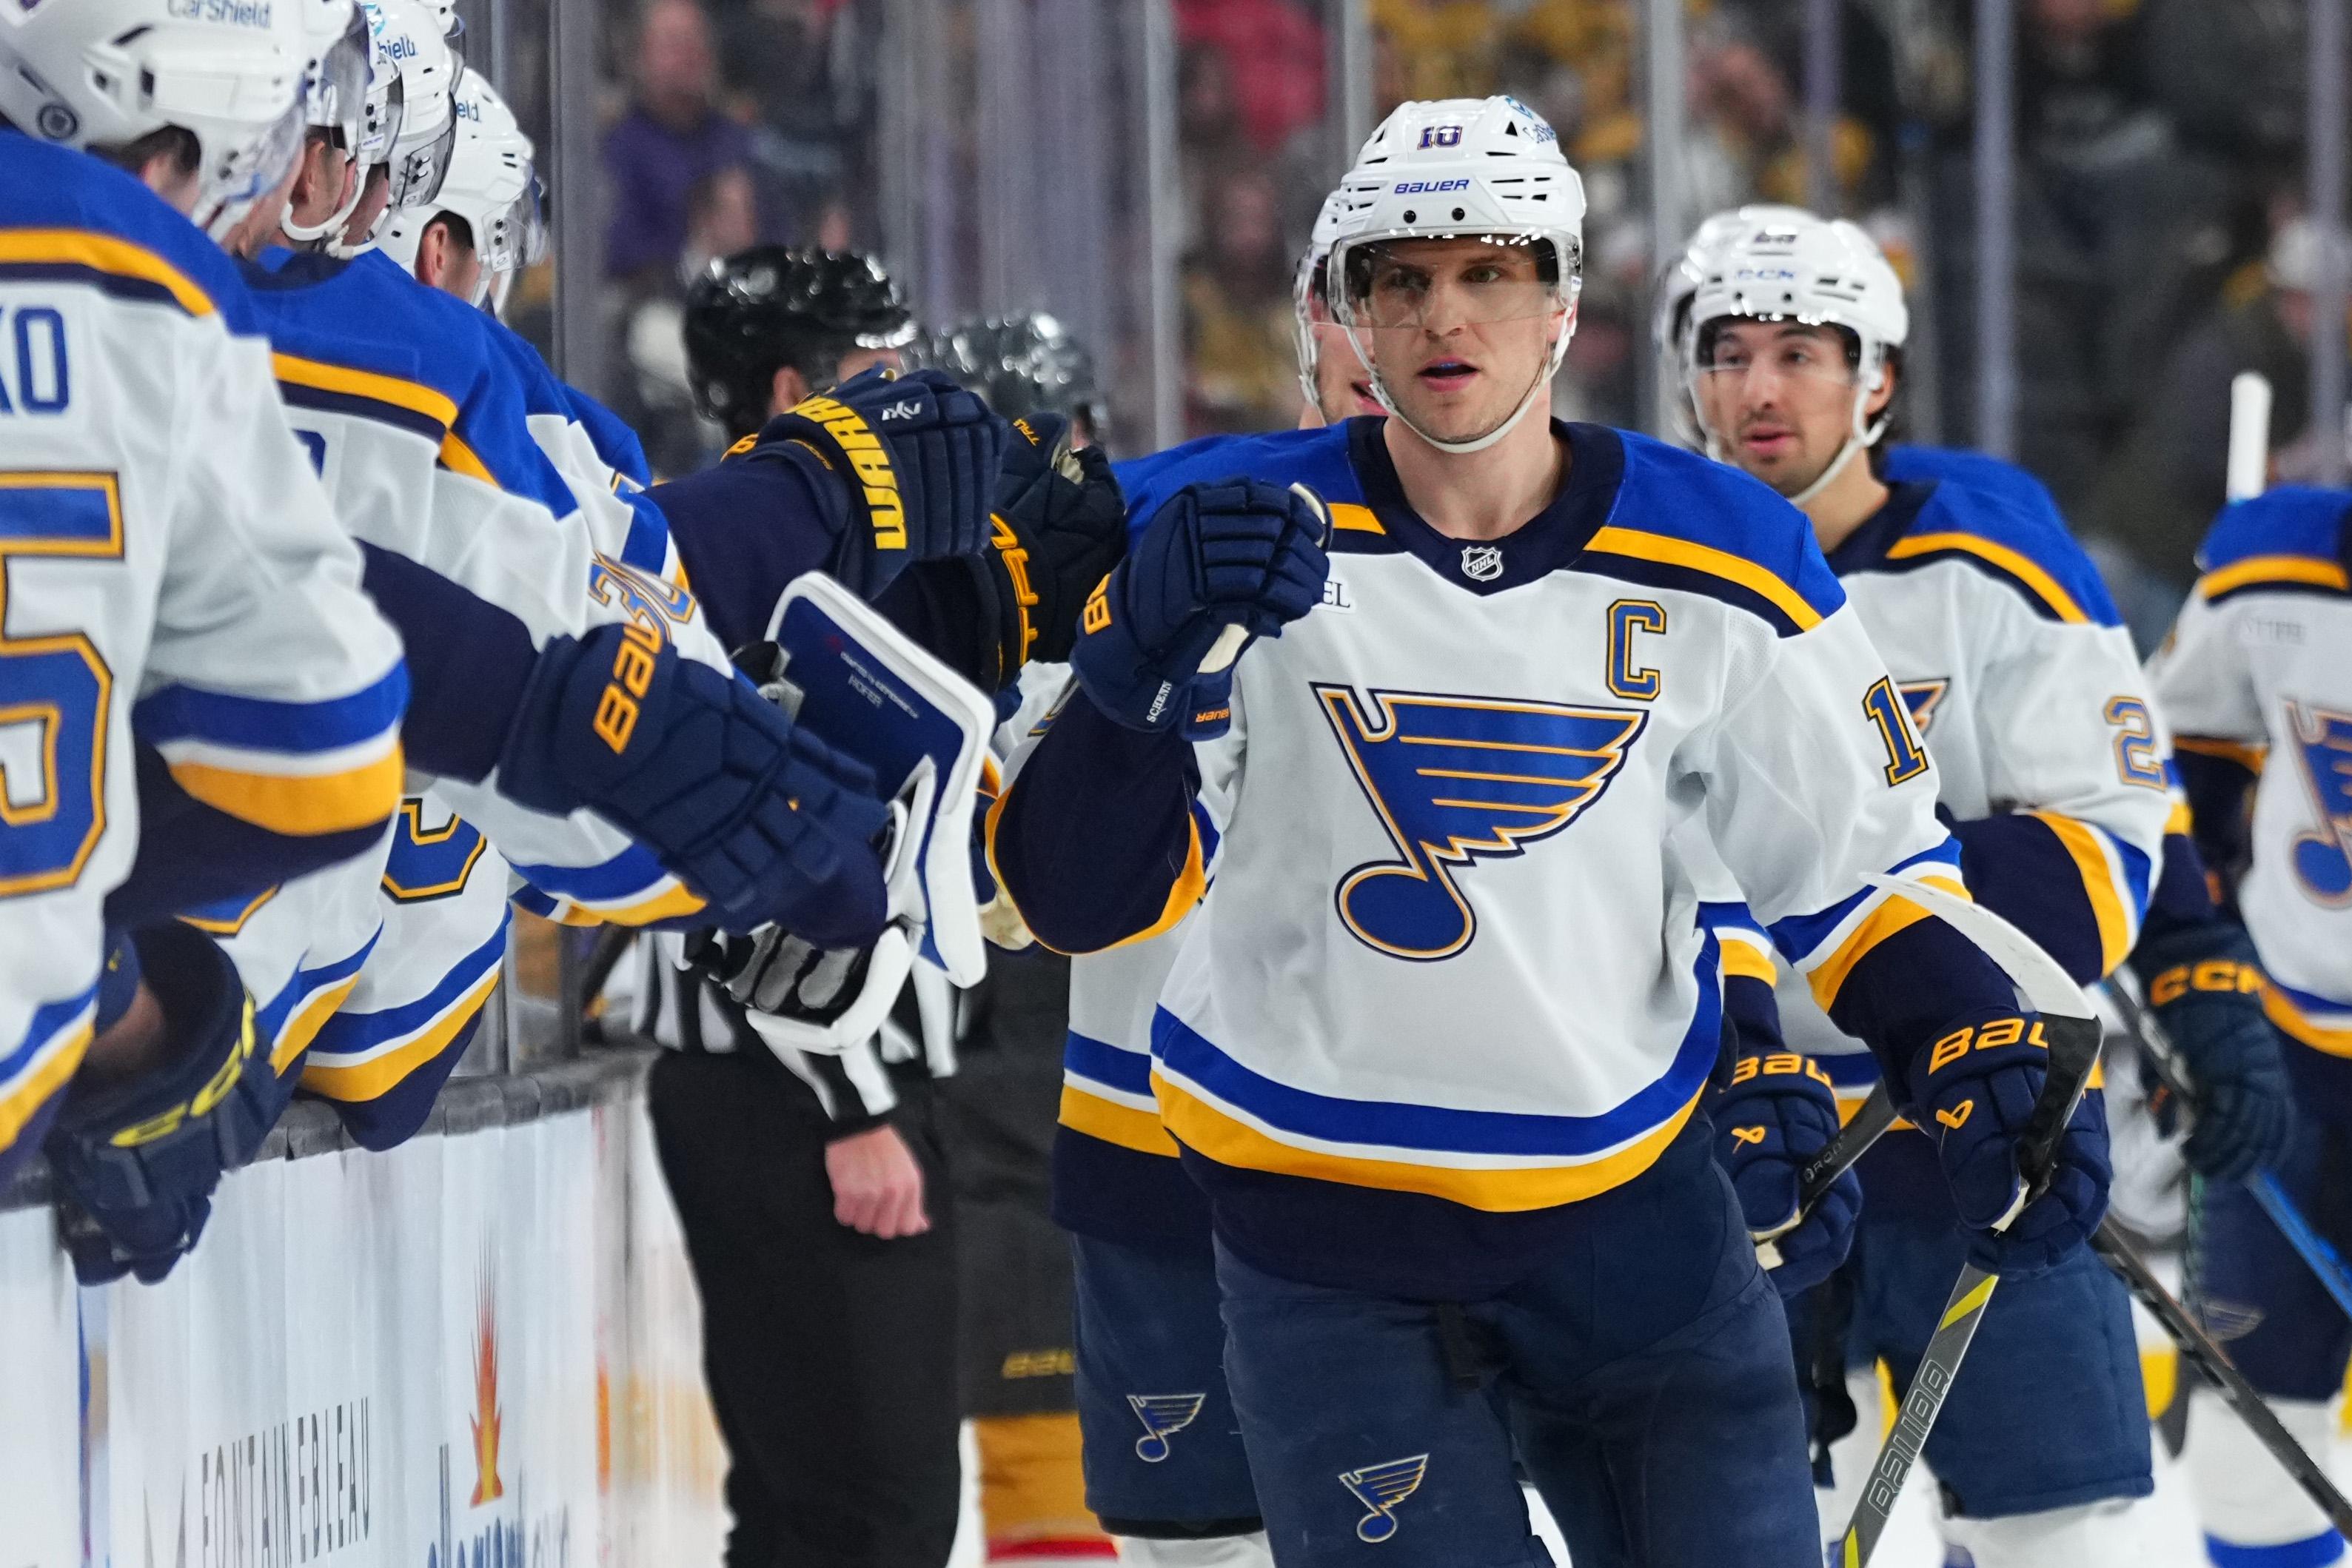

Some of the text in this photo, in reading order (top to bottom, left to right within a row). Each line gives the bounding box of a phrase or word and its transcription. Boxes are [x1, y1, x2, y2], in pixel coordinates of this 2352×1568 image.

[1416, 124, 1463, 150] 10
[1394, 179, 1470, 194] BAUER
[1471, 556, 1493, 573] NHL
[1605, 598, 1666, 700] C
[1146, 680, 1173, 723] SCHENN
[1928, 1017, 2048, 1076] BAU
[1732, 1053, 1832, 1088] BAU
[201, 1396, 369, 1568] FONTAINEBLEAU
